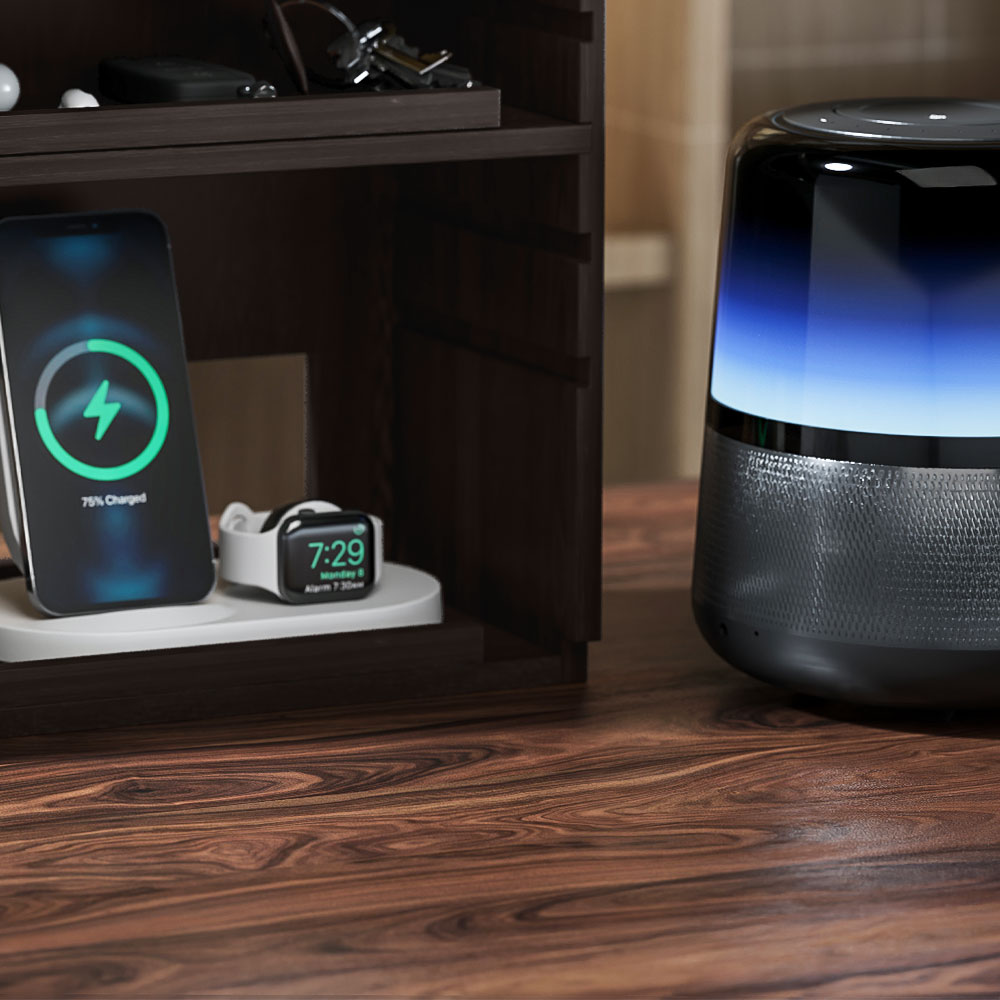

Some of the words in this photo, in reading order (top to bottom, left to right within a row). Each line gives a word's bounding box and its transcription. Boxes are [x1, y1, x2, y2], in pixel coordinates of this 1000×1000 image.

[81, 495, 104, 508] 75%
[105, 492, 147, 506] Charged
[308, 538, 365, 569] 7:29
[320, 569, 356, 580] Monday
